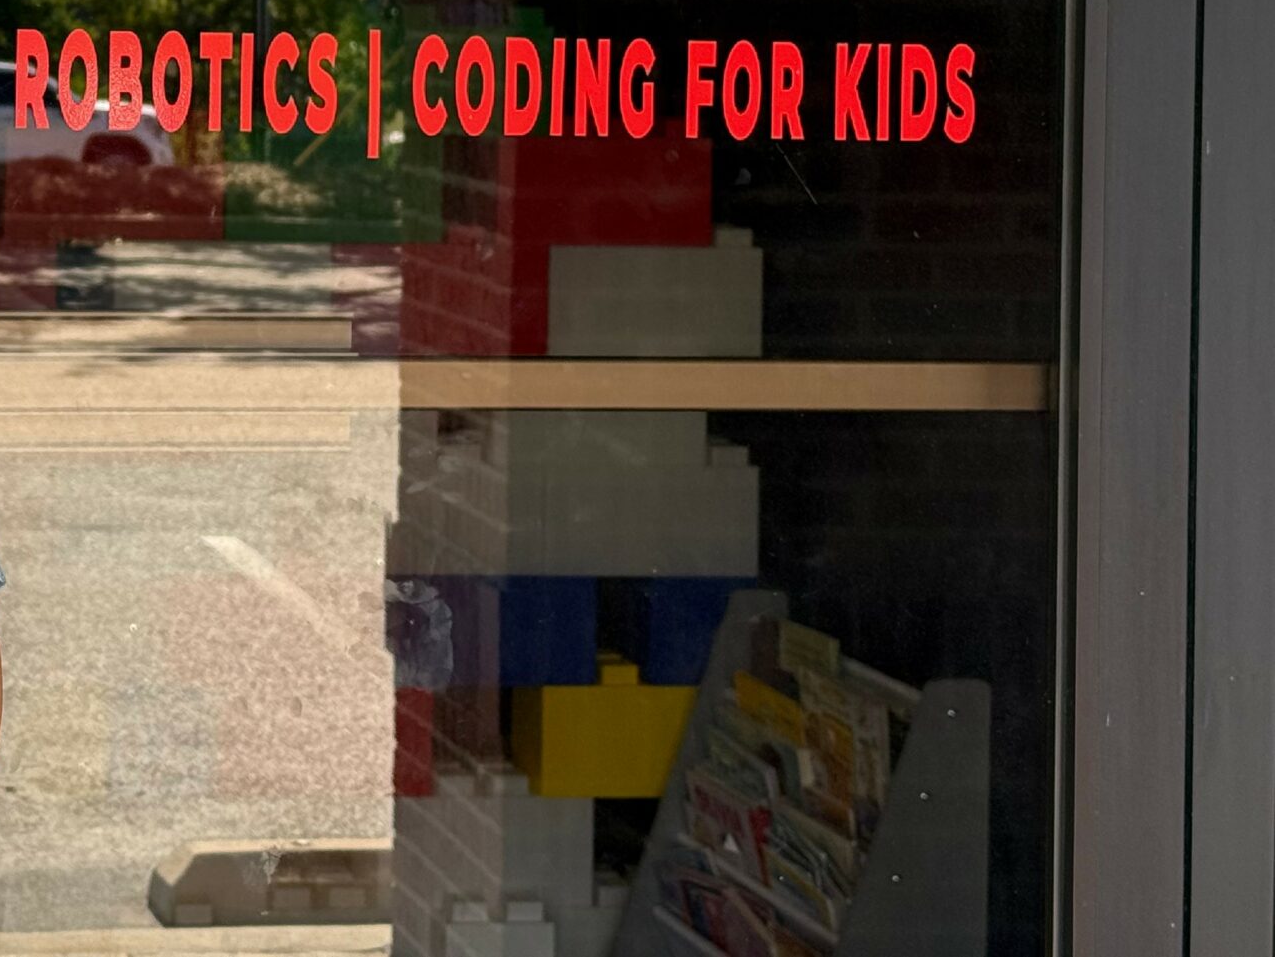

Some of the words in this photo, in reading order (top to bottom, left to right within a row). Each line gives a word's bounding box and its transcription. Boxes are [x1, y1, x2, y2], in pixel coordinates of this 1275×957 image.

[14, 28, 339, 135] ROBOTICS
[412, 34, 656, 139] CODING
[685, 40, 804, 141] FOR
[834, 42, 976, 144] KIDS
